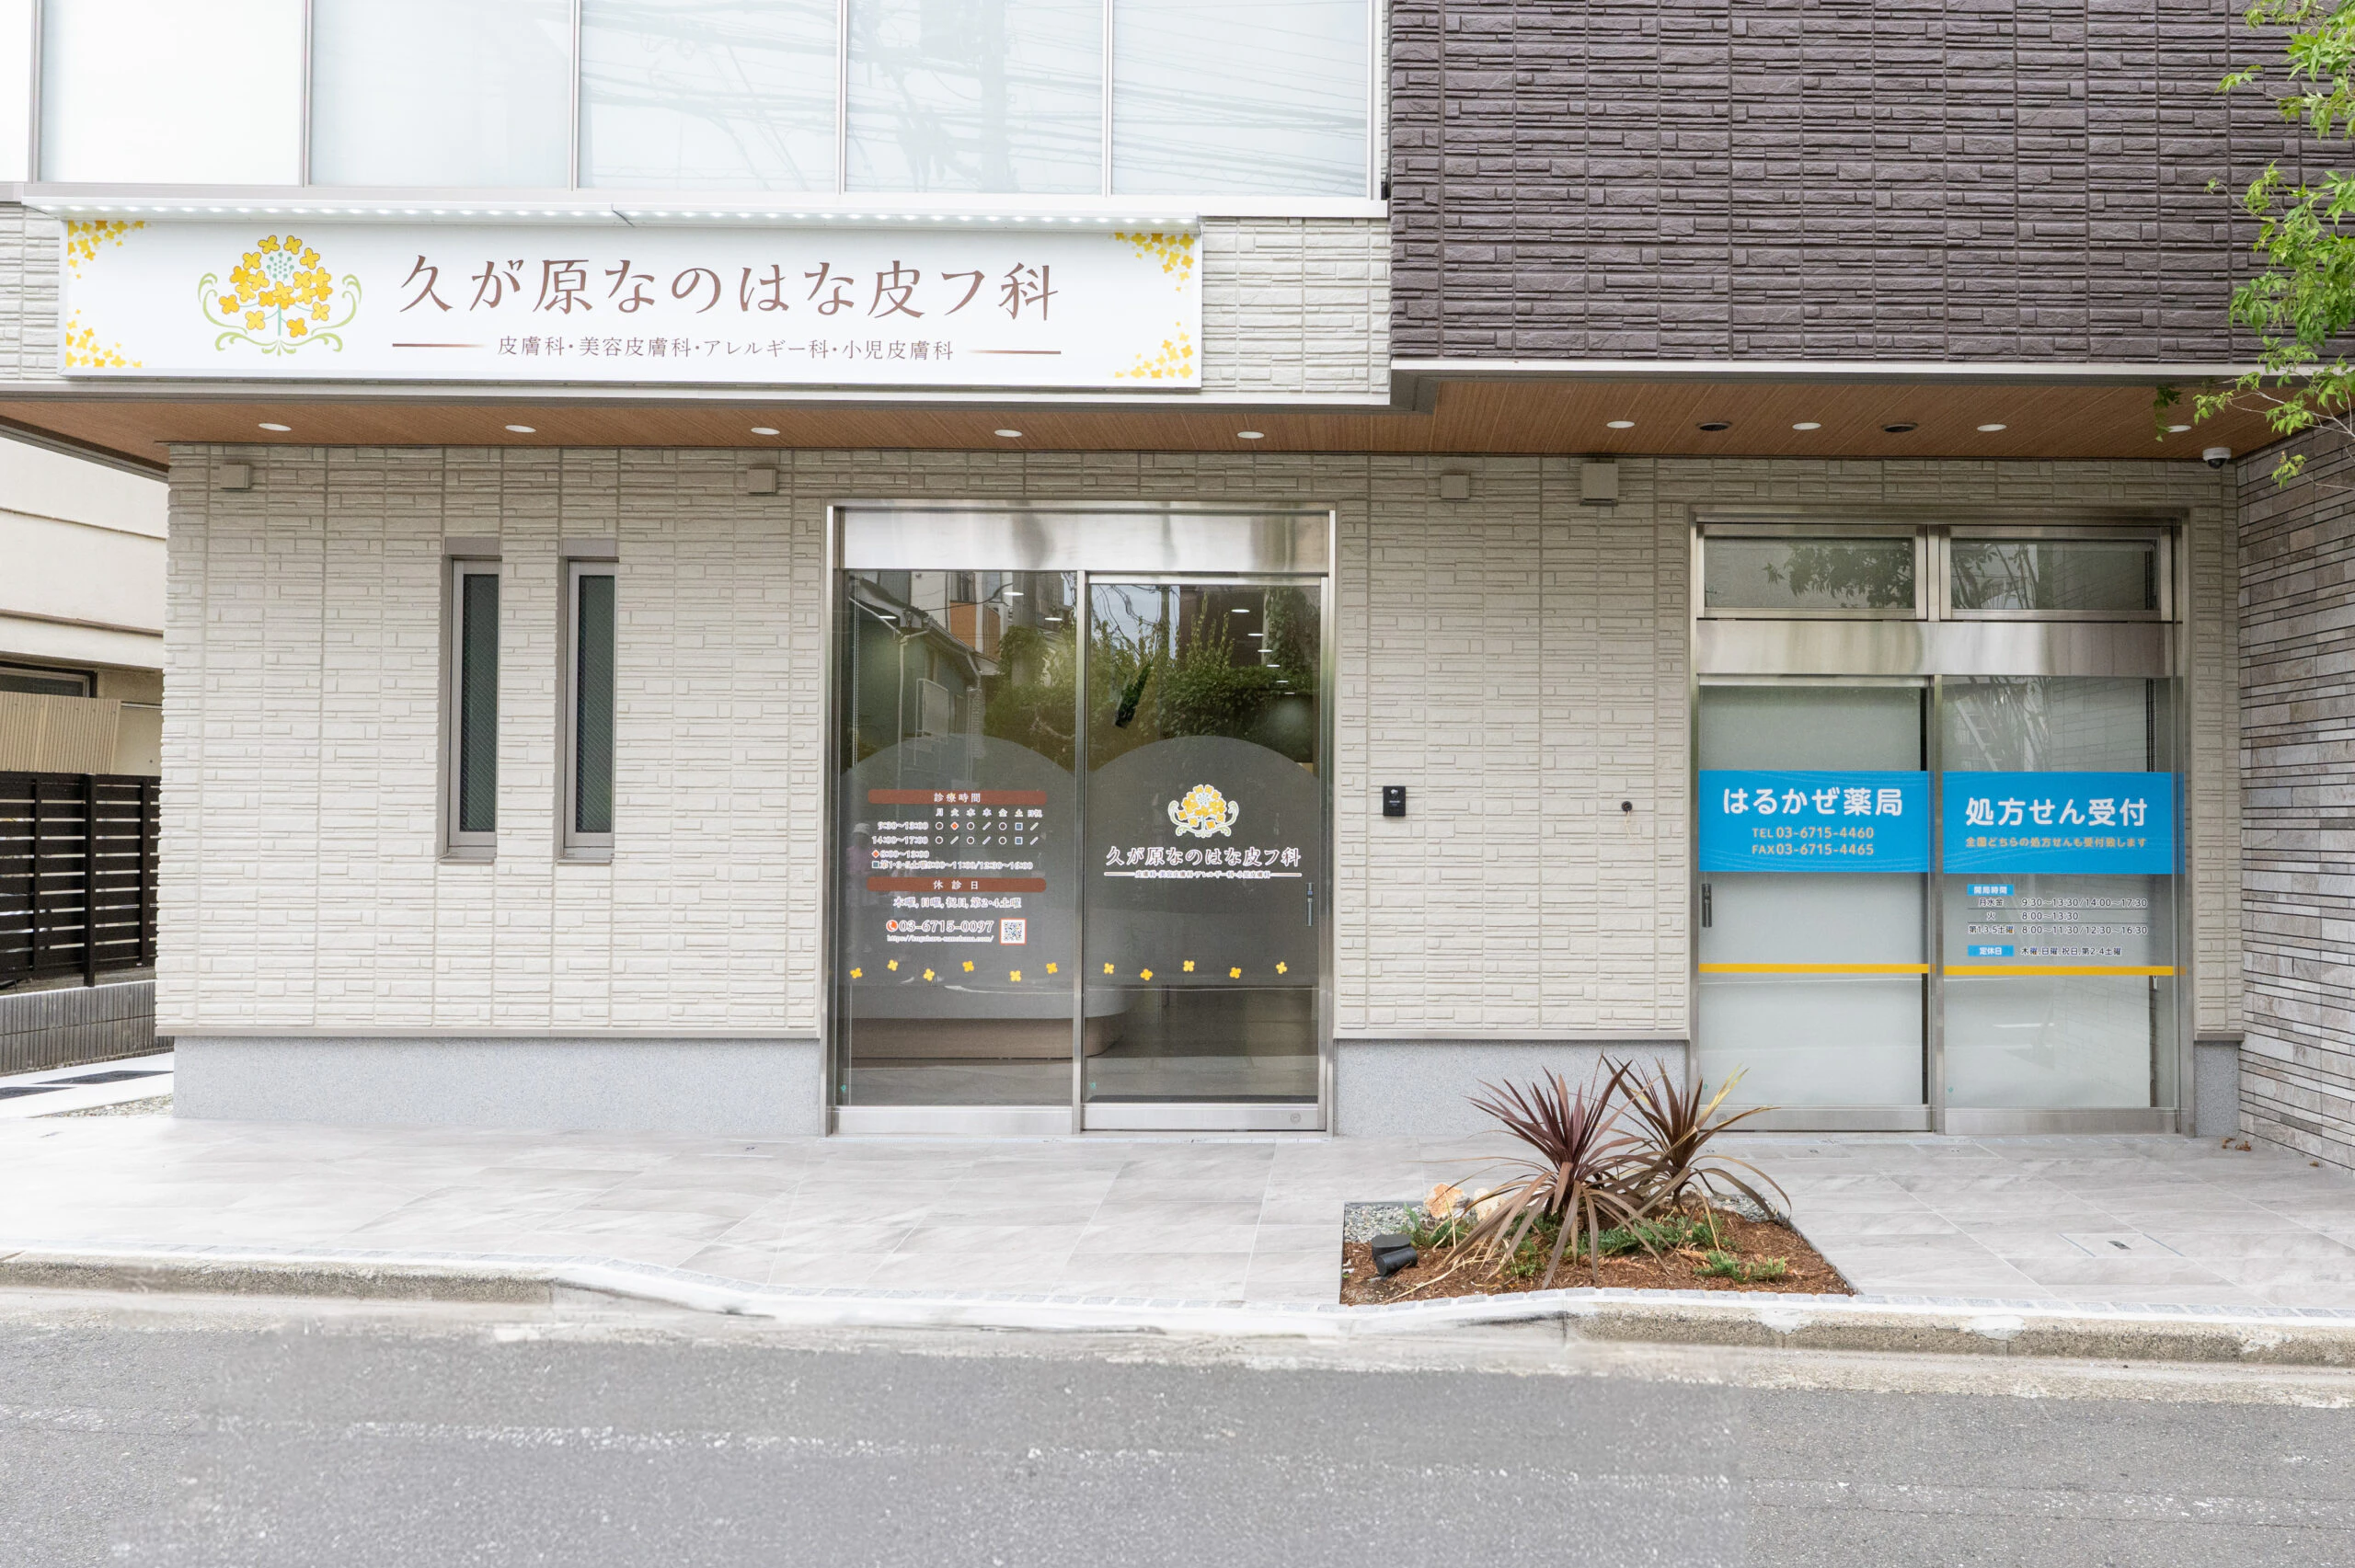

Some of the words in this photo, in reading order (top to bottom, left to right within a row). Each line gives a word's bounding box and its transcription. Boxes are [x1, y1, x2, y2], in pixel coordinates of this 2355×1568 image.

[399, 255, 1059, 322] 久が原なのはな皮フ科
[498, 335, 953, 361] 皮膚科・美容皮膚科・アレルギー科・小児皮膚科
[934, 792, 982, 803] 診療時間
[1723, 786, 1902, 817] はるかぜ薬局
[1965, 797, 2148, 827] 処方せん受付
[1752, 828, 1774, 838] TEL
[1776, 826, 1875, 839] 03-6715-4460
[1752, 844, 1775, 855] FAX
[1776, 843, 1875, 855] 03-6715-4465
[1106, 846, 1302, 867] 久が原なのはな皮フ科
[933, 880, 980, 890] 休診日
[1979, 898, 2004, 907] 月水金
[1986, 911, 1995, 920] 火
[898, 920, 994, 933] 03-6715-0097
[1979, 946, 2003, 956] 定休日
